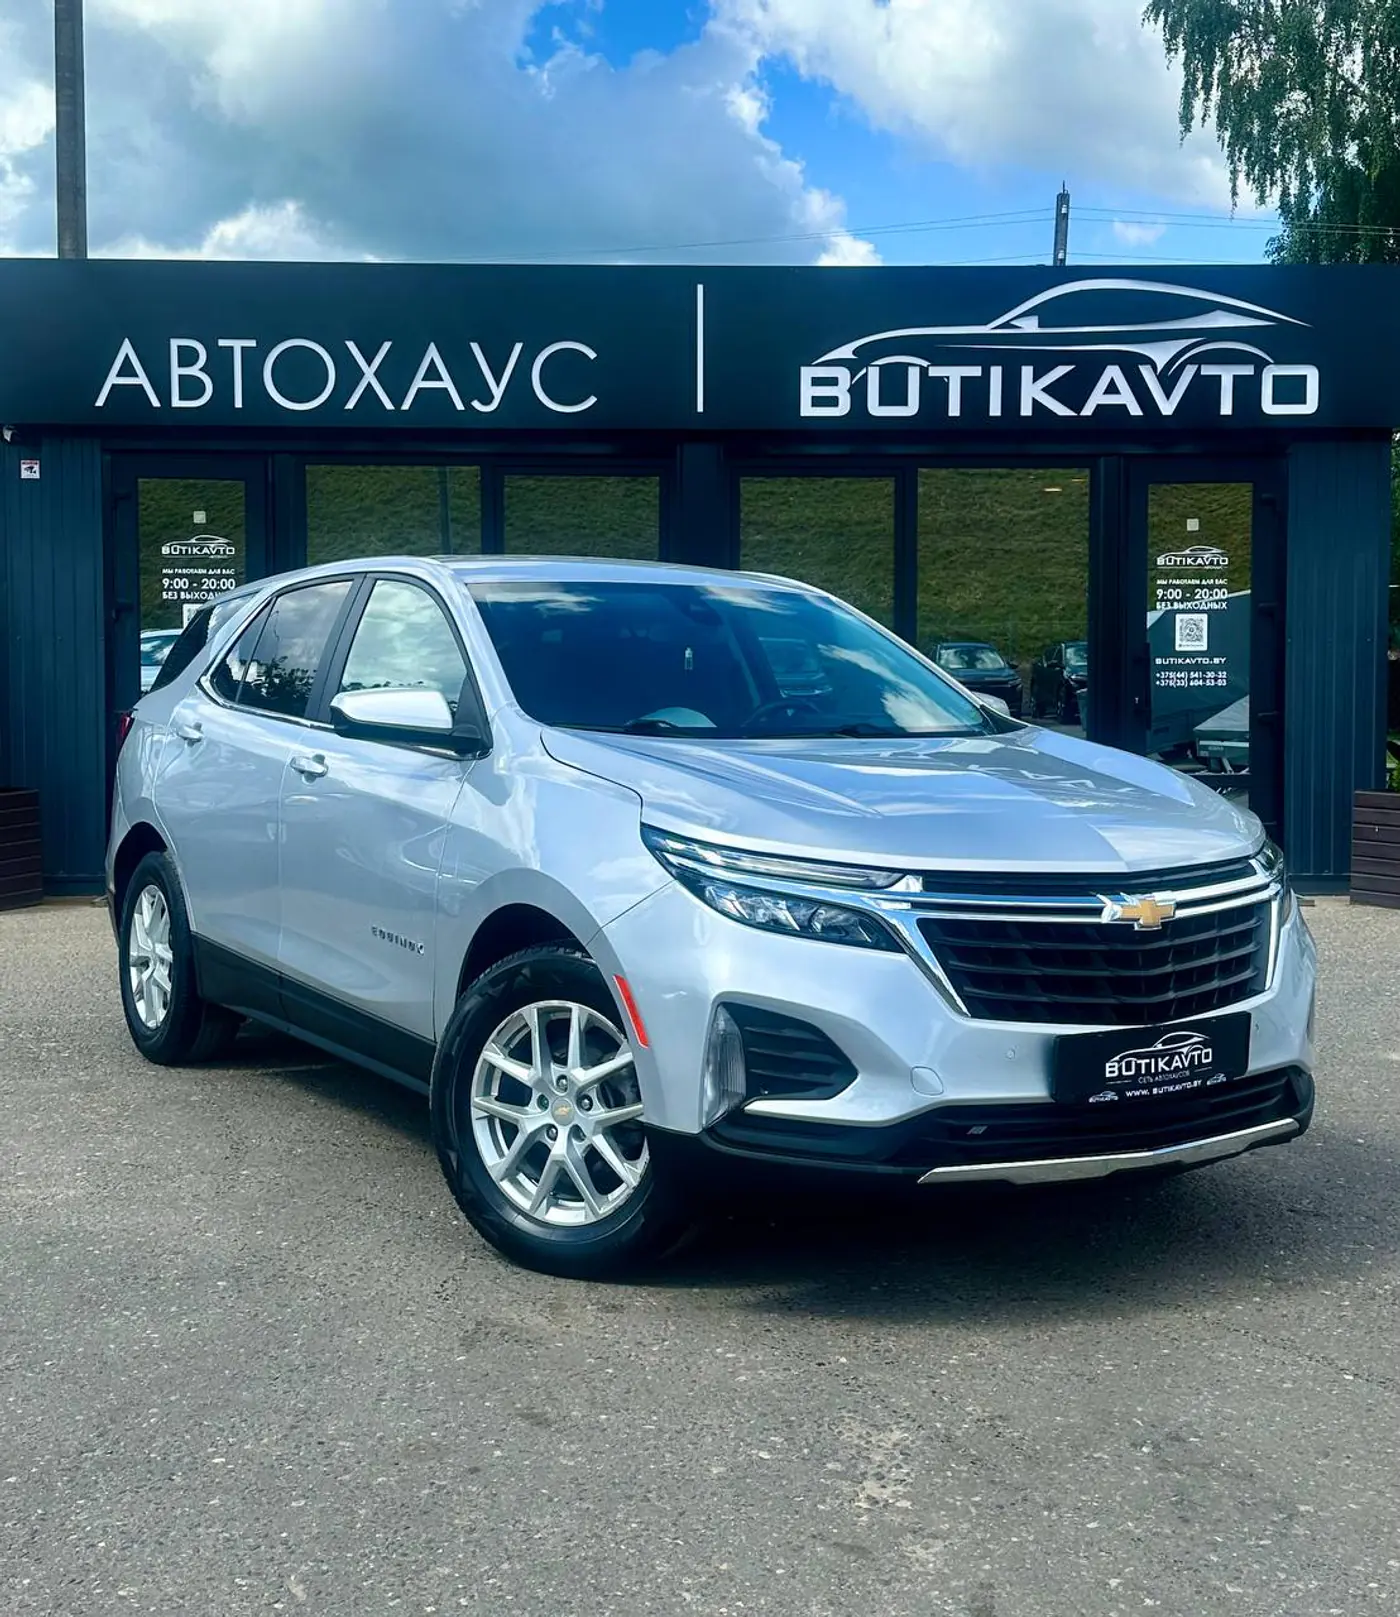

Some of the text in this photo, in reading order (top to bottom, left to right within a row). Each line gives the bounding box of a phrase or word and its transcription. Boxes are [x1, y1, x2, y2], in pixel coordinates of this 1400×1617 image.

[95, 337, 598, 413] АВТОХАУС
[800, 364, 1319, 416] BUTIKAVTO
[161, 545, 235, 555] BUTIKAVTO
[1156, 556, 1229, 565] BUTIKAVTO
[162, 578, 189, 590] 9:00
[201, 578, 236, 590] 20:00
[162, 591, 222, 600] БЕЗ ВЫХОД
[1156, 588, 1182, 600] 9:00
[1194, 588, 1228, 600] 20:00
[1156, 601, 1227, 610] БЕЗ ВЫХОДНЫХ
[1155, 657, 1227, 665] BUTIKAVTO.BY
[1105, 1048, 1212, 1078] BUTIKAVTO
